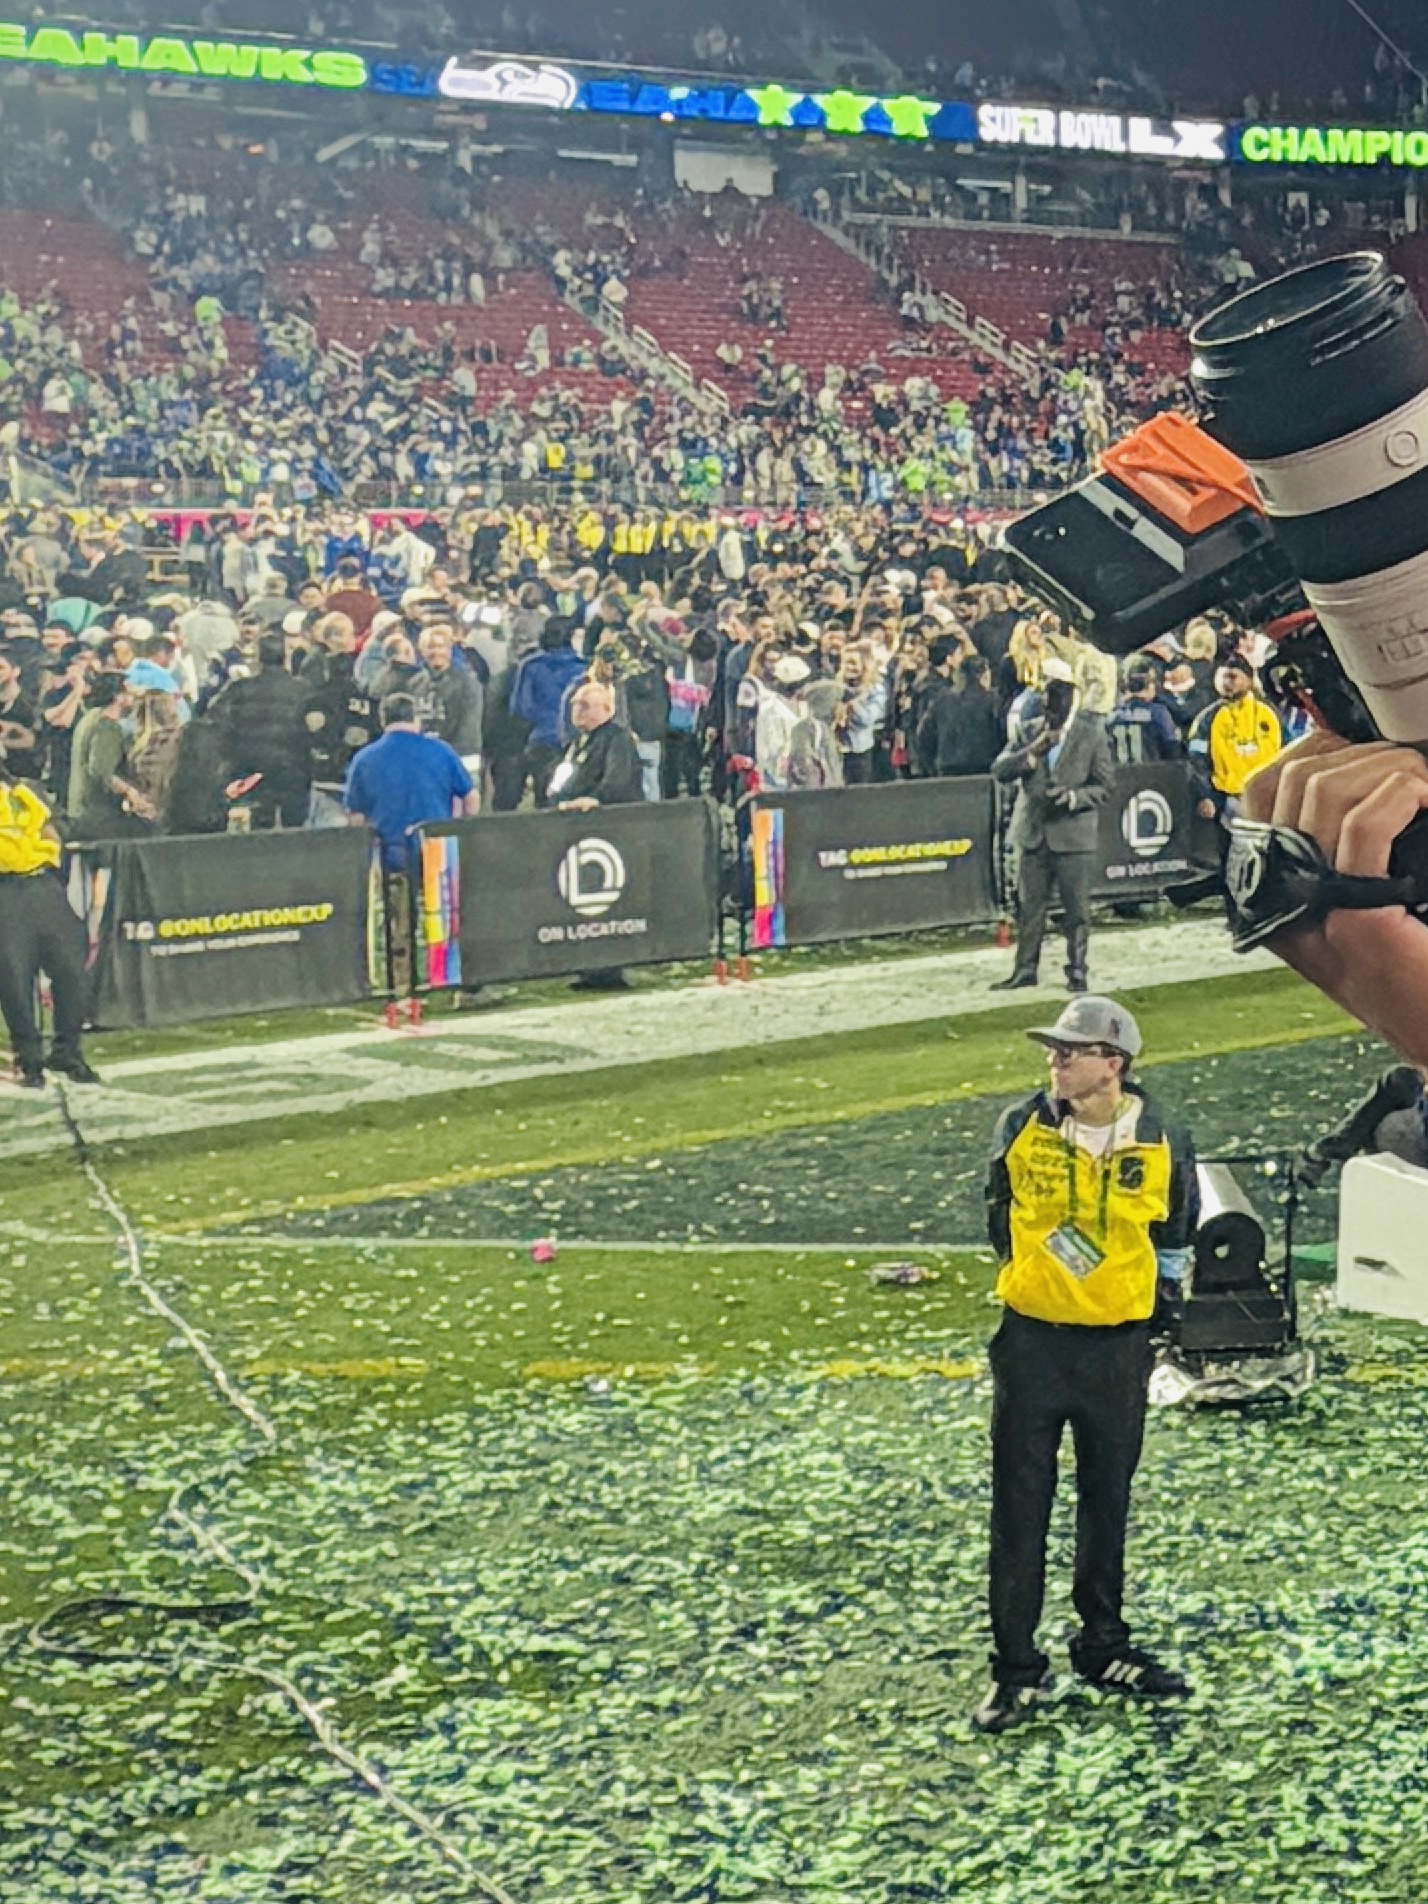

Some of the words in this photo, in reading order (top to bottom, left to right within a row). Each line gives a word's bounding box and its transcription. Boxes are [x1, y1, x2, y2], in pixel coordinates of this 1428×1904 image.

[977, 104, 1052, 147] SUPER
[1056, 109, 1127, 152] BOWL
[1127, 116, 1225, 161] LX
[538, 924, 564, 945] ON
[566, 917, 648, 942] LOCATION
